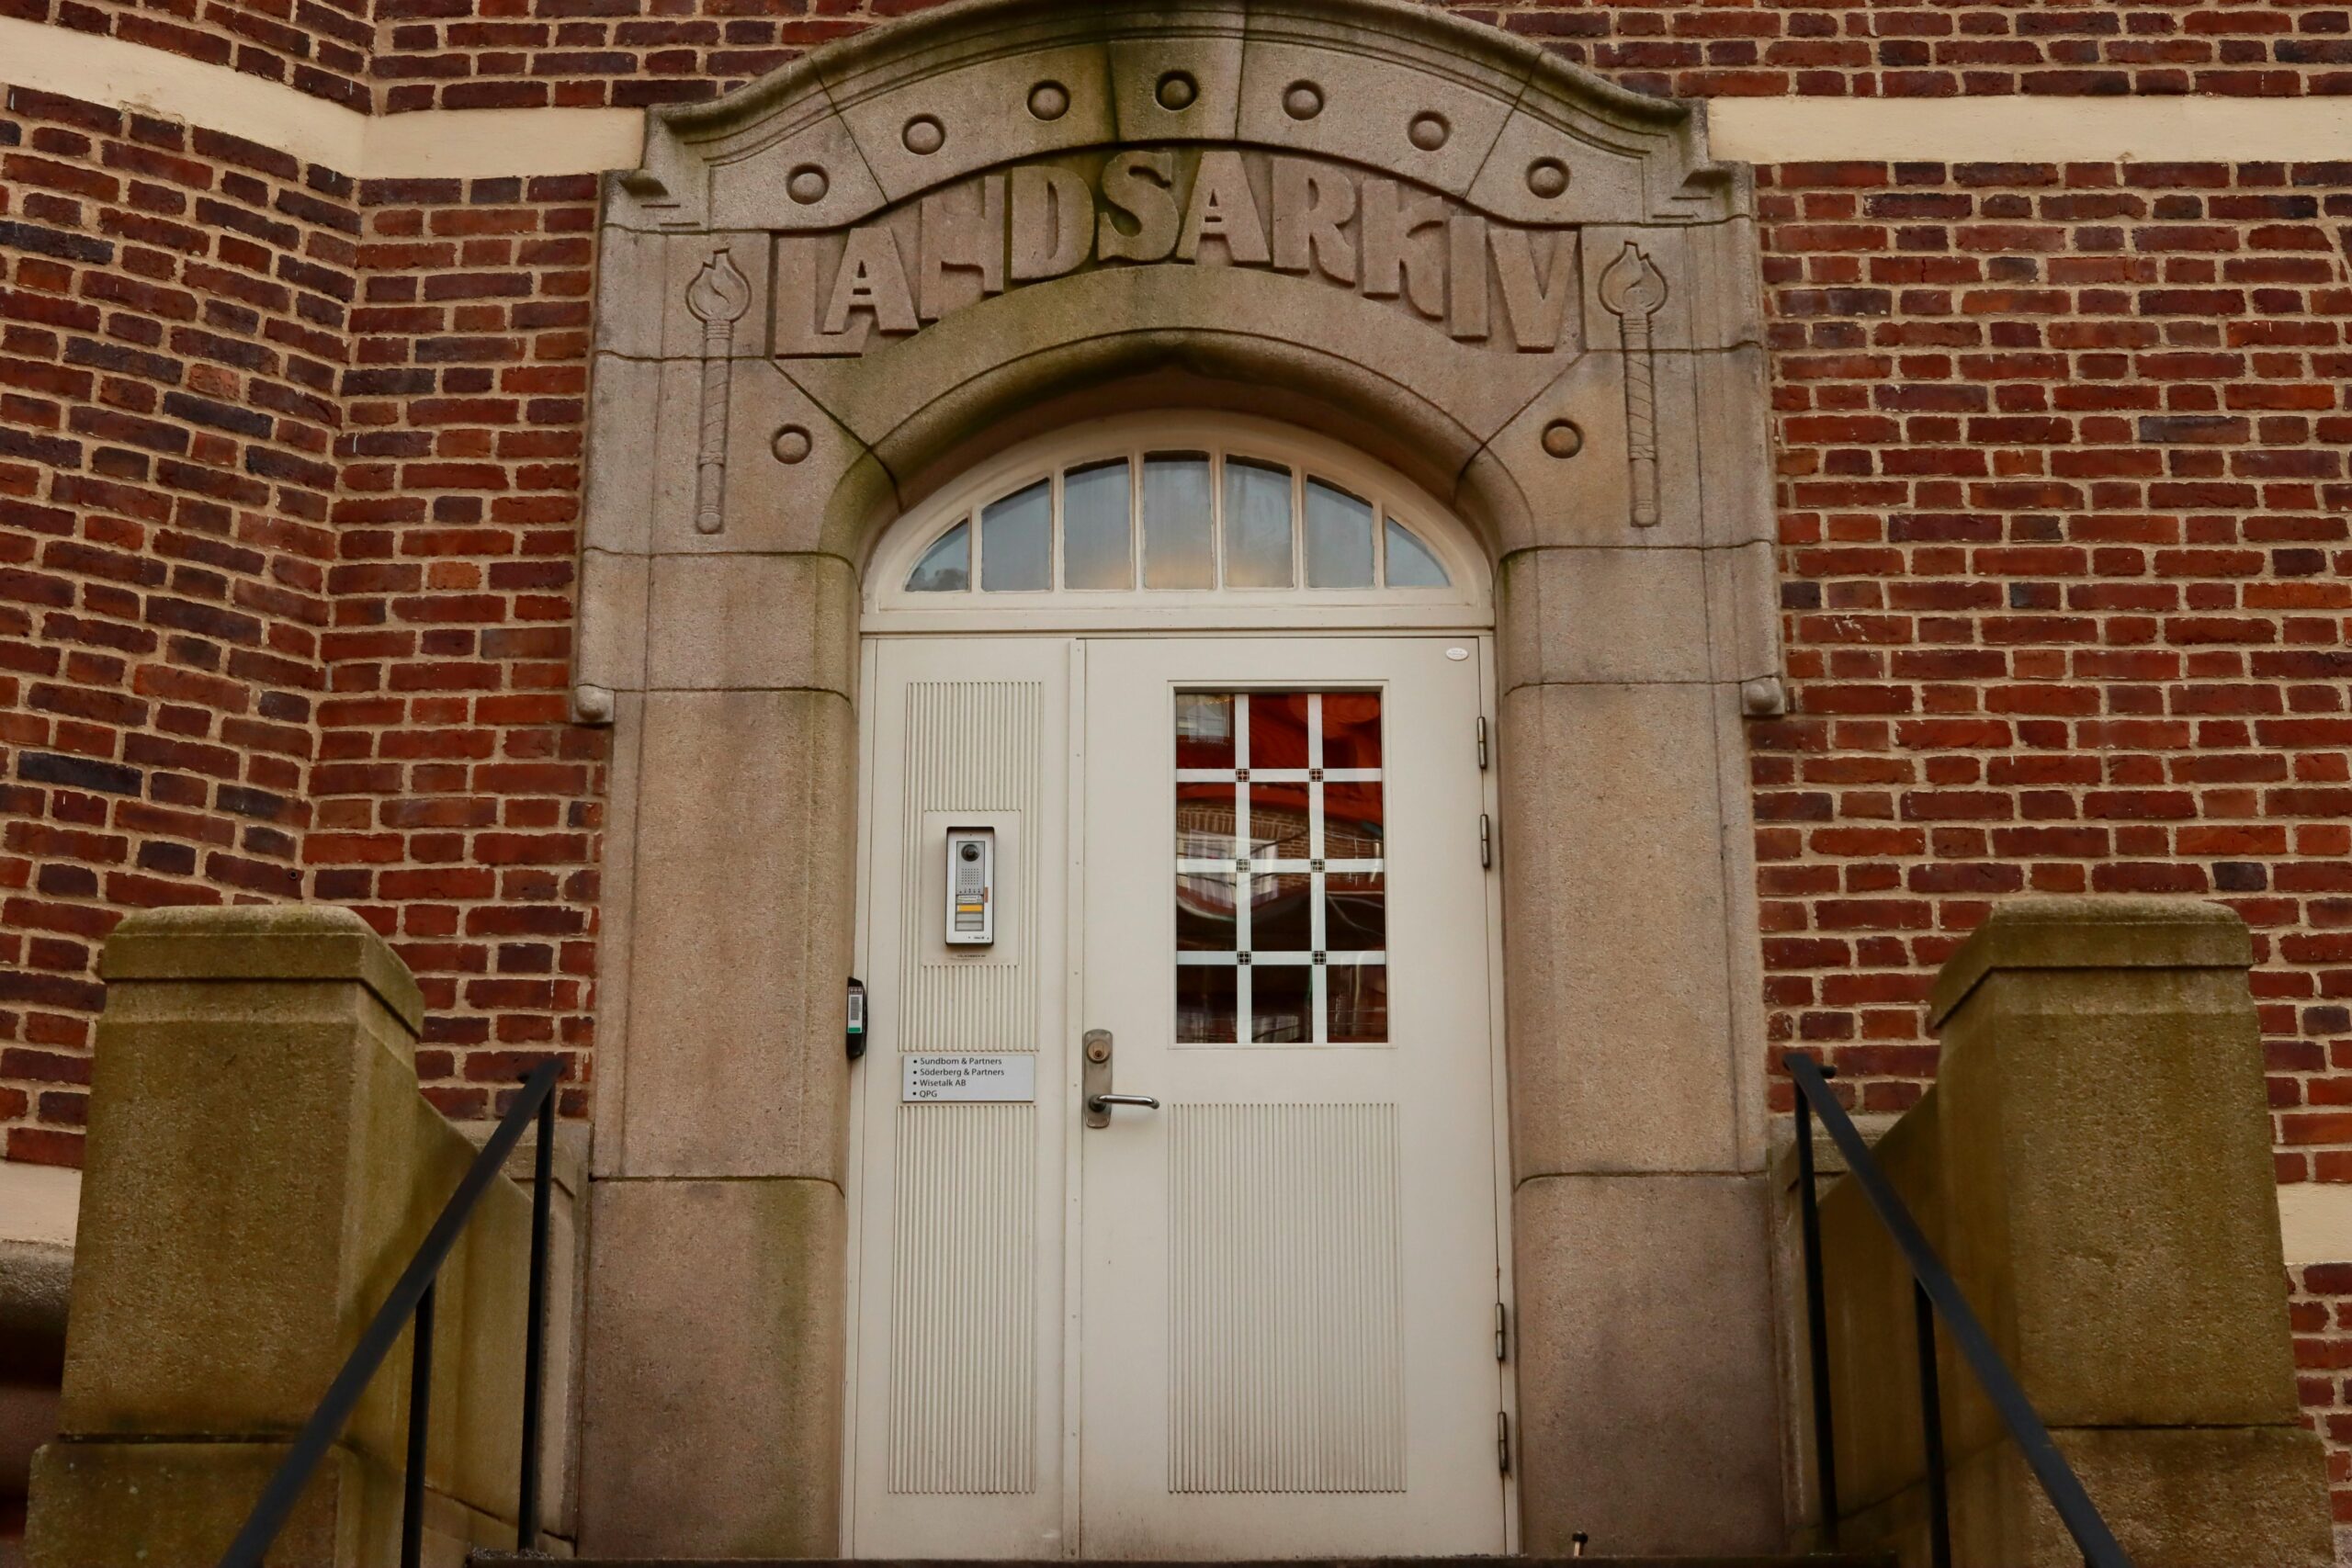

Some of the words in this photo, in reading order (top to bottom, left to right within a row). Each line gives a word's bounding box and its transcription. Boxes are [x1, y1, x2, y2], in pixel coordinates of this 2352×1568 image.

[775, 150, 1578, 356] LANDSARKIV
[920, 1068, 962, 1077] Söderberg
[920, 1090, 937, 1099] QPG
